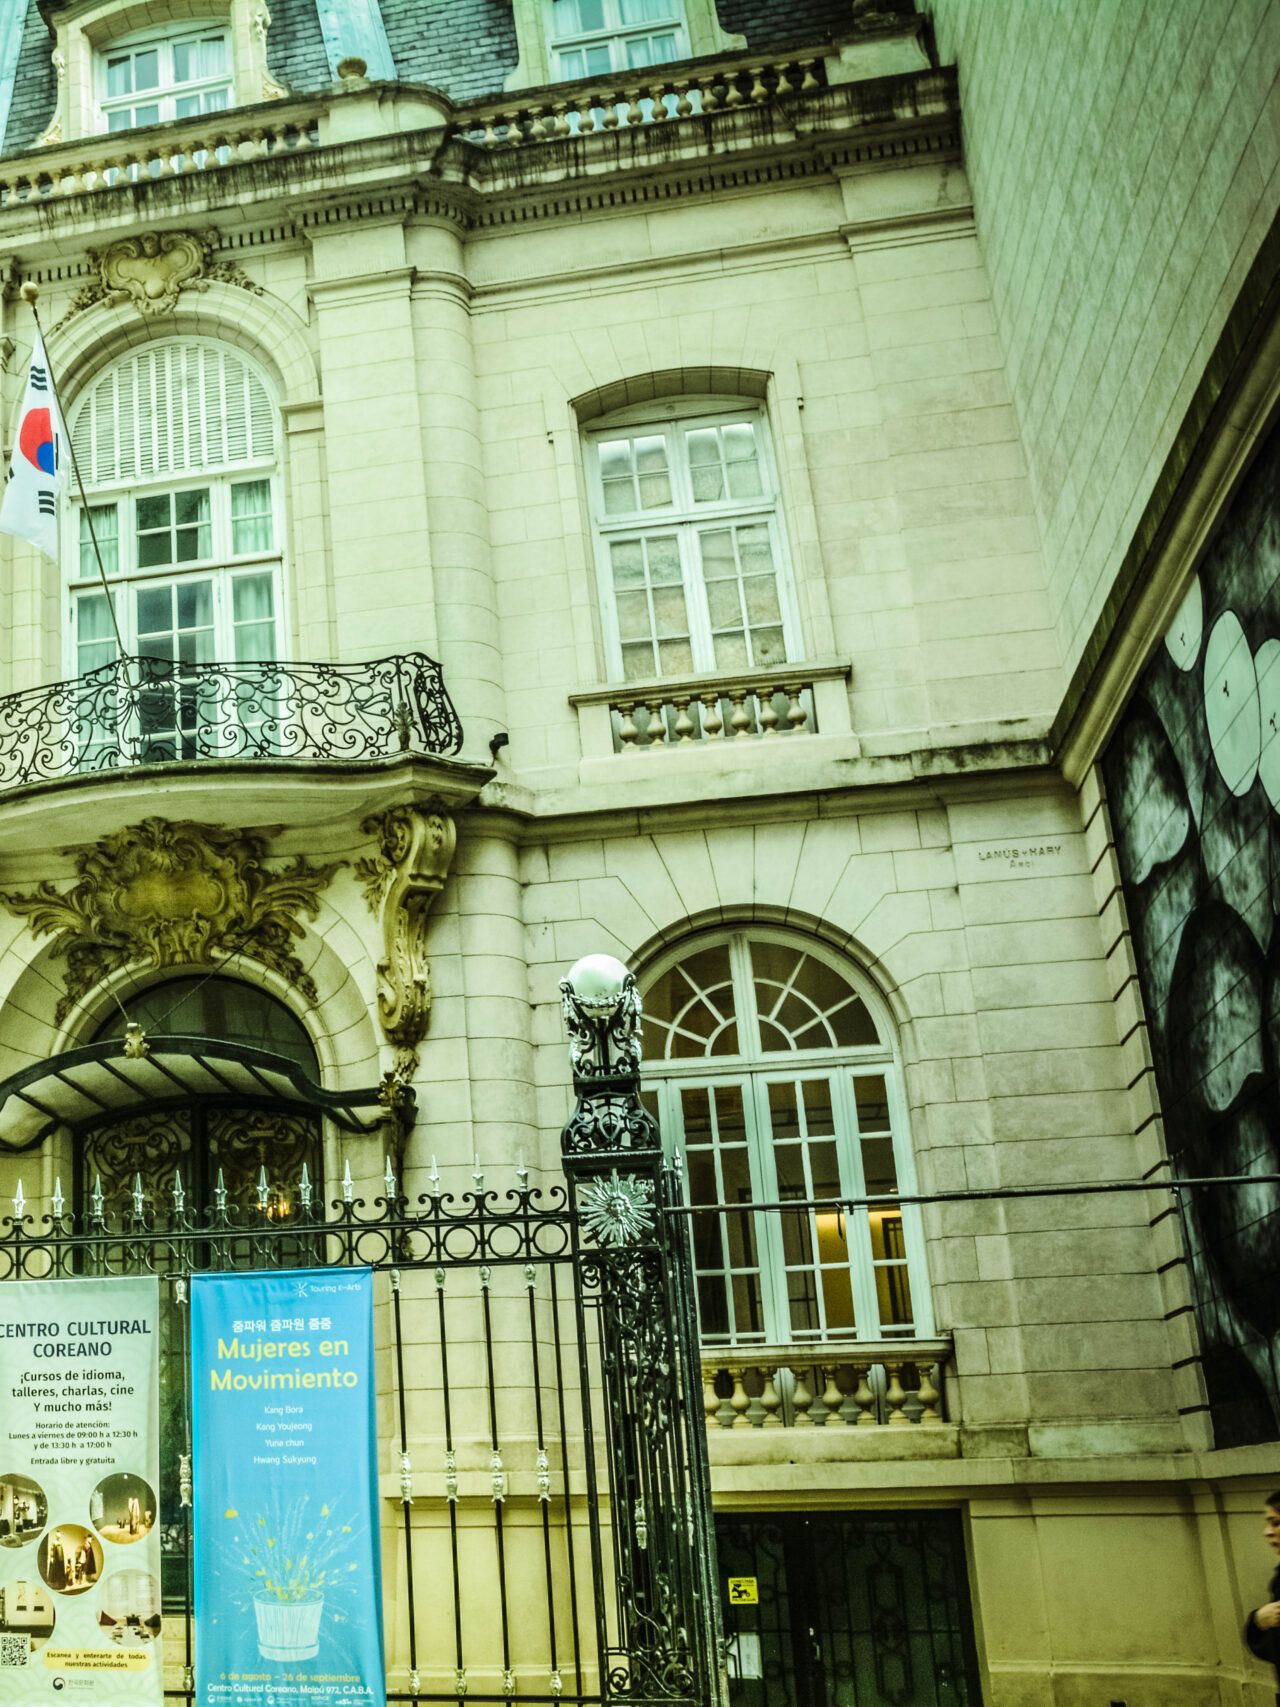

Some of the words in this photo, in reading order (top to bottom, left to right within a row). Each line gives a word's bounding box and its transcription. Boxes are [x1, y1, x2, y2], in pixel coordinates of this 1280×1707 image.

[67, 1320, 151, 1336] CULTURAL
[33, 1342, 112, 1358] COREANO
[217, 1338, 311, 1361] Mujeres
[319, 1340, 349, 1356] en
[20, 1371, 61, 1384] ¡Cursos
[65, 1371, 79, 1380] de
[82, 1369, 125, 1381] idioma,
[211, 1368, 358, 1391] Movimiento
[12, 1387, 58, 1398] talleres,
[62, 1385, 107, 1397] charlas,
[110, 1384, 134, 1394] cine
[34, 1402, 41, 1412] Y
[44, 1402, 82, 1412] mucho
[85, 1400, 112, 1411] más!
[264, 1406, 284, 1415] Kang
[256, 1423, 275, 1432] Kang
[278, 1422, 312, 1432] Youjeong
[112, 1430, 131, 1438] 12:30
[87, 1441, 105, 1449] 17:00
[265, 1439, 284, 1447] Yuna
[31, 1457, 59, 1465] Entrada
[86, 1457, 115, 1466] gratuita
[254, 1455, 280, 1465] Hwang
[283, 1455, 317, 1465] Sukyung
[242, 1673, 272, 1682] agosto
[296, 1673, 307, 1681] de
[310, 1674, 360, 1682] septiembre
[208, 1684, 232, 1692] Centro
[233, 1684, 263, 1692] Cultural
